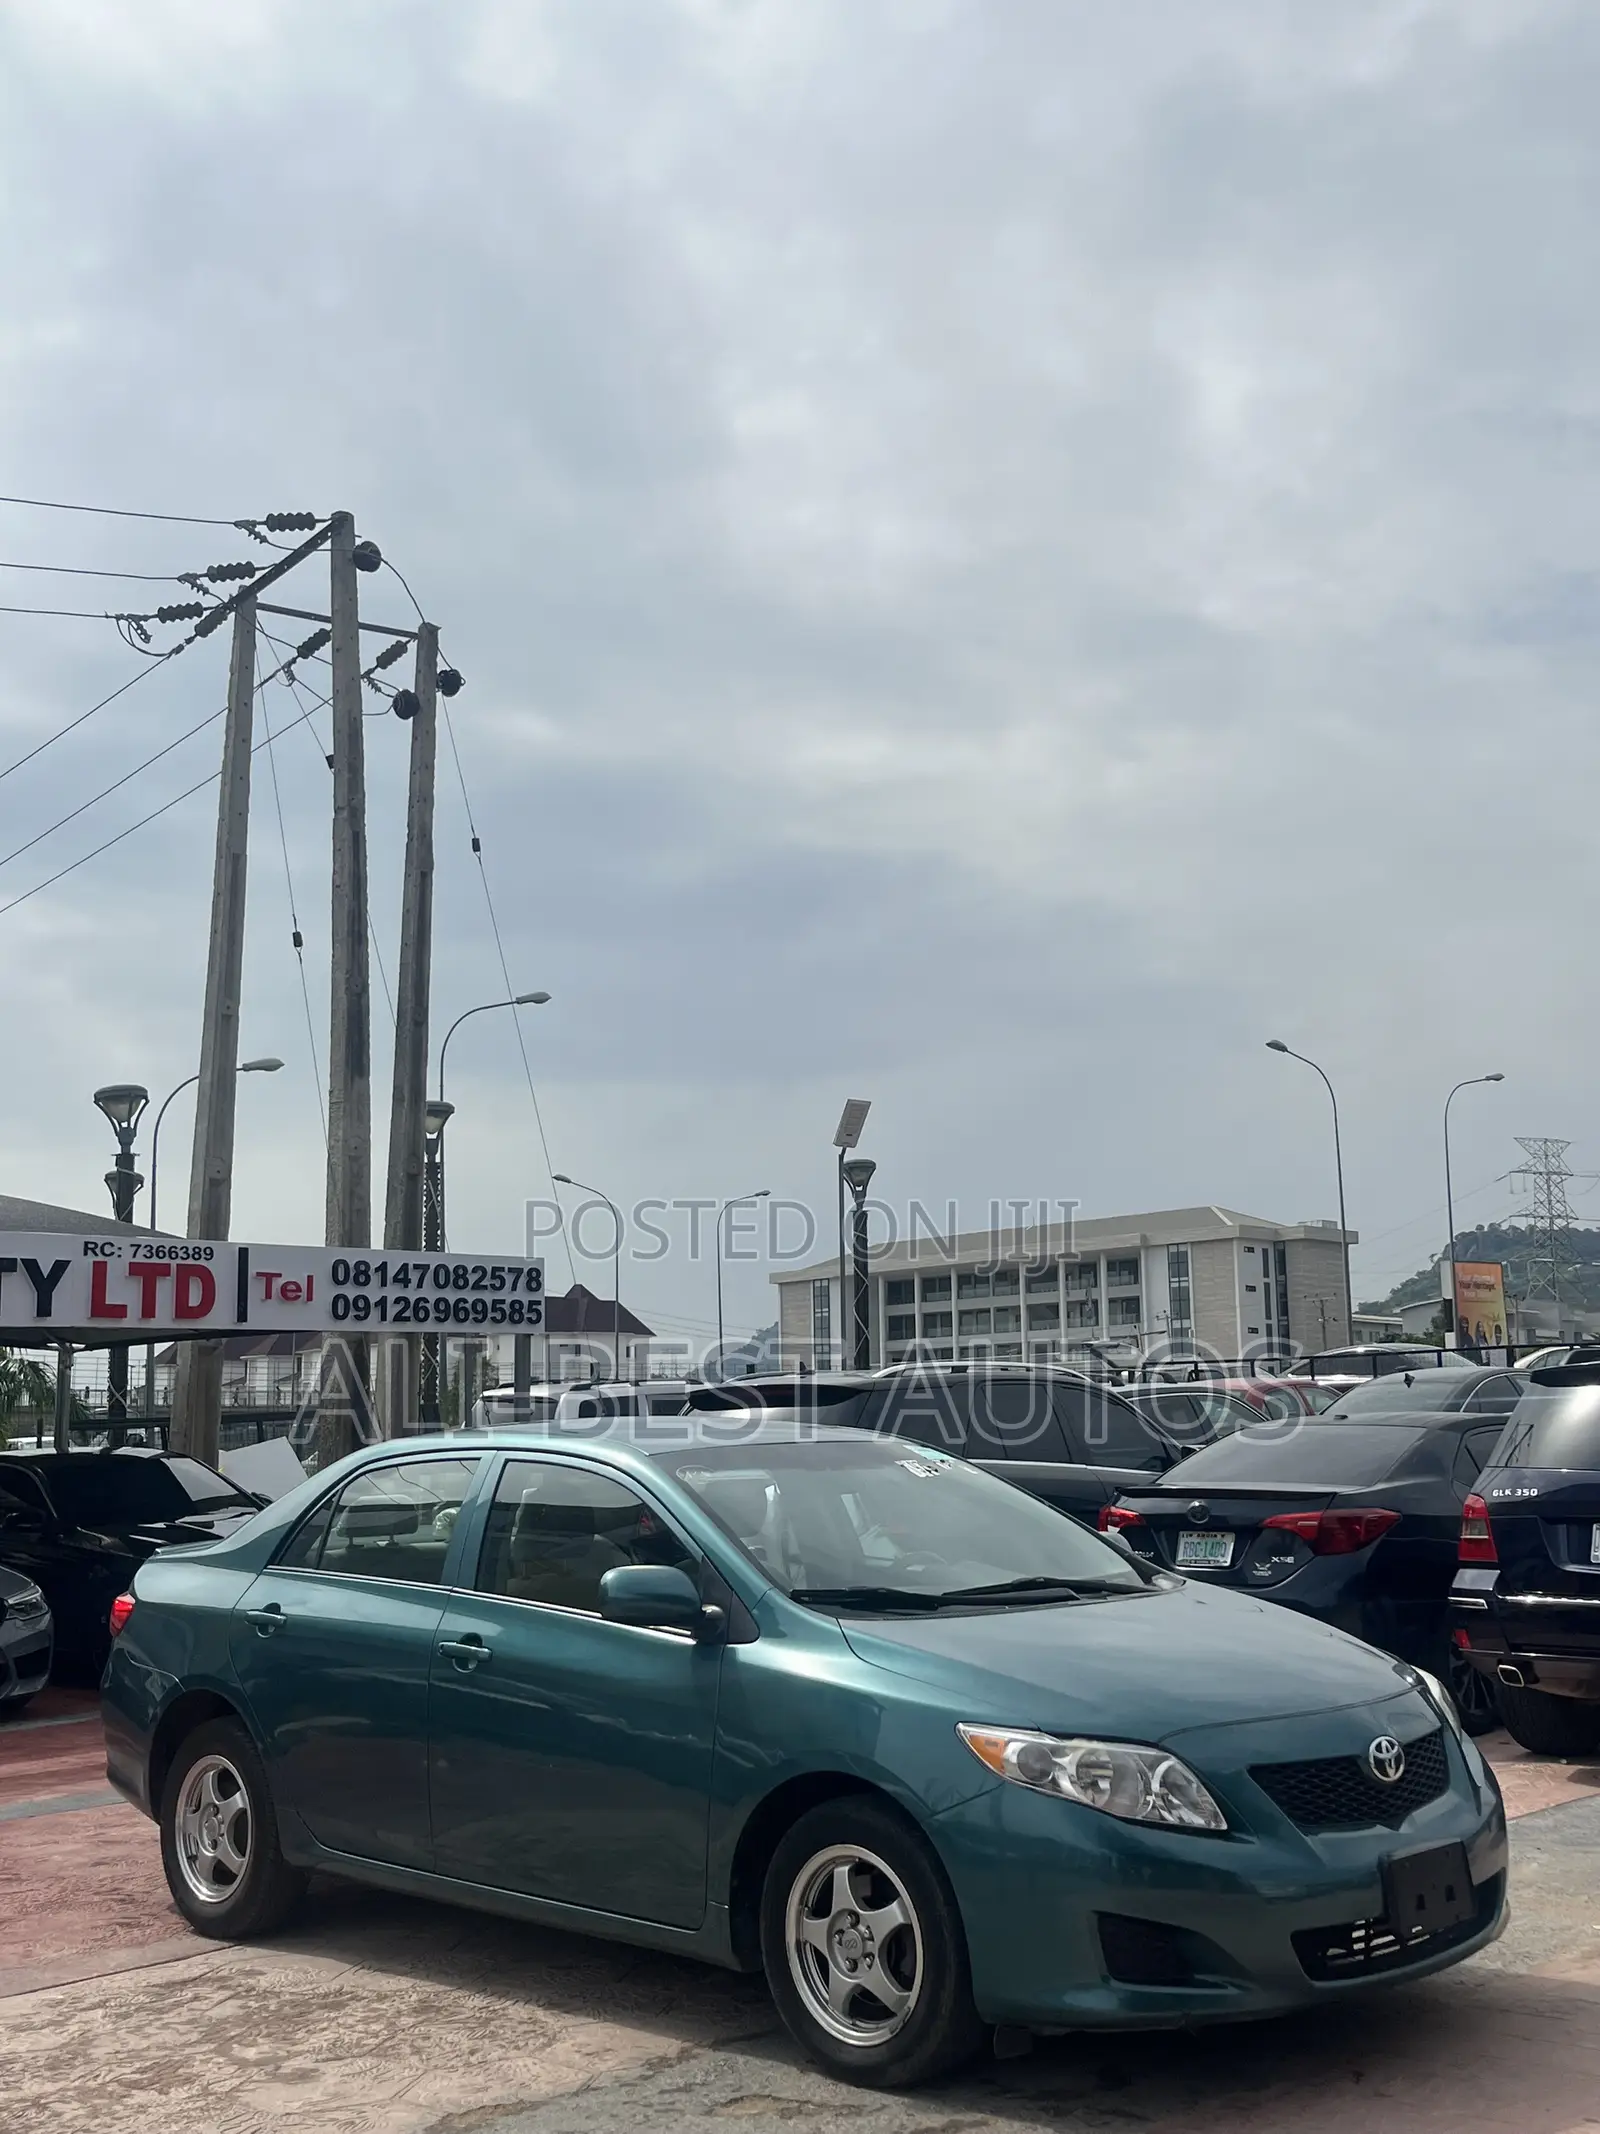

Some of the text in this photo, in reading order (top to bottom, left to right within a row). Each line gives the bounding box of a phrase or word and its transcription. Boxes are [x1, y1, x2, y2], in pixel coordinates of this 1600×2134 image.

[83, 1240, 214, 1261] RC: 7366389
[90, 1260, 216, 1319] LTD
[256, 1271, 314, 1302] Tel
[331, 1258, 543, 1293] 08147082578
[331, 1294, 543, 1325] 09126969585
[1492, 1488, 1539, 1497] GLK 350
